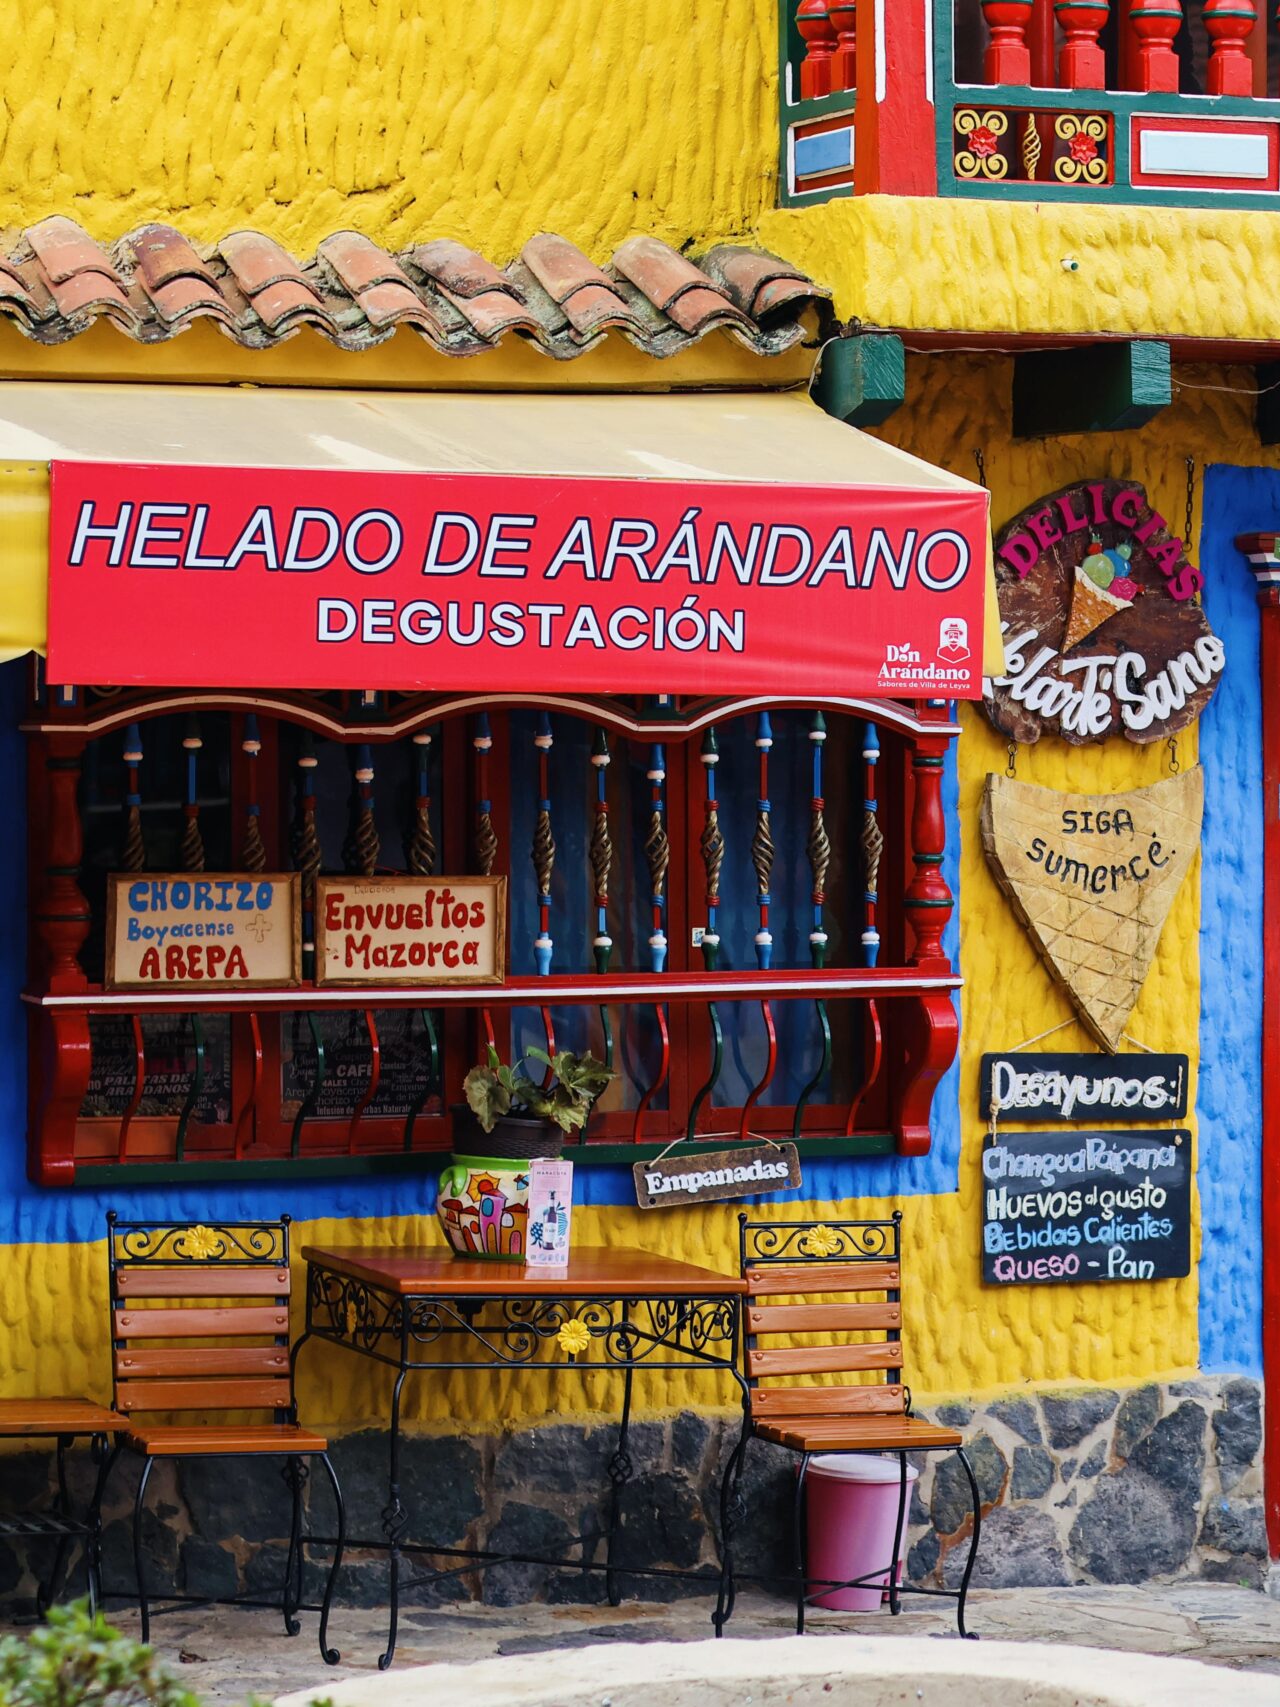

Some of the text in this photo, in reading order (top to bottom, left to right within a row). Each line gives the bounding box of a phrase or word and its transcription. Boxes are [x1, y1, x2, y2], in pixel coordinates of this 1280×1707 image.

[67, 500, 971, 592] HELADO DE ARÁNDANO
[1000, 484, 1204, 602] DELICIAS
[317, 595, 745, 652] DEGUSTACIÓN
[878, 662, 970, 681] Arándano
[1062, 809, 1134, 837] SIGA
[128, 880, 273, 912] CHORIZO
[326, 888, 485, 931] Envueltos
[127, 917, 235, 947] Boyacense
[139, 944, 249, 979] AREPA
[344, 933, 480, 970] Mazorca
[645, 1159, 789, 1195] Empanadas
[1085, 1185, 1097, 1204] al
[1100, 1176, 1166, 1220] gusto
[1108, 1245, 1155, 1280] Pan
